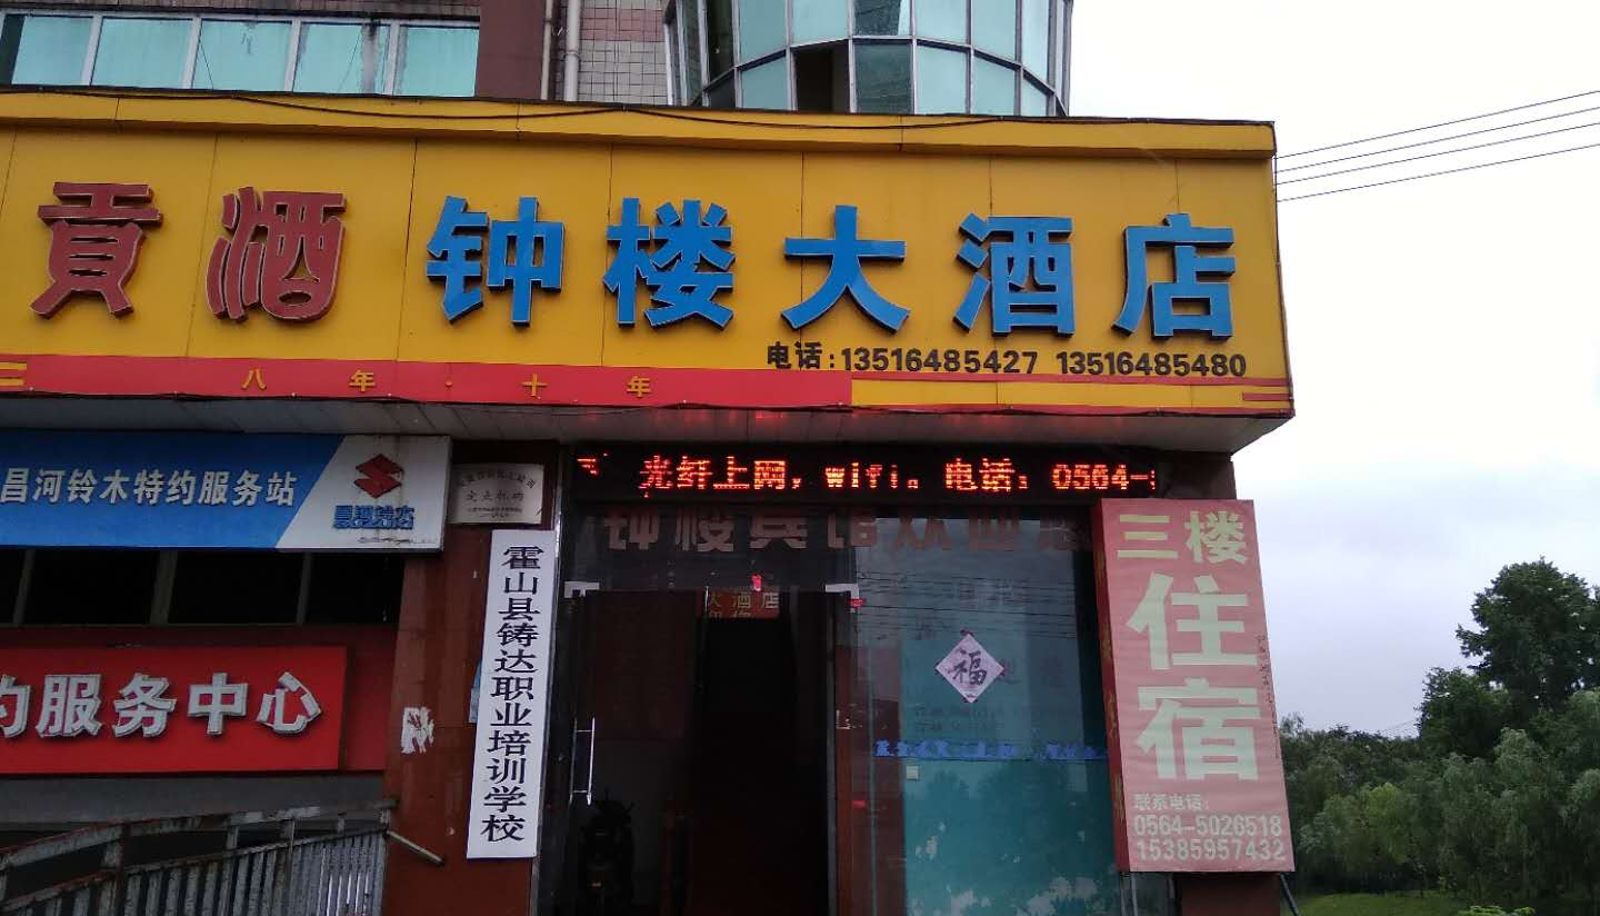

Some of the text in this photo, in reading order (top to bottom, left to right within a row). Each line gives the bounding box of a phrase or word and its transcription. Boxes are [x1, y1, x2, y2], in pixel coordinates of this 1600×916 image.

[29, 181, 347, 323] 贡酒
[426, 195, 1236, 340] 钟楼大酒店
[1056, 350, 1246, 378] 13516485480
[1, 467, 297, 506] 昌河铃木特约服务站
[1051, 462, 1156, 492] 0564-
[1117, 510, 1248, 565] 三楼
[950, 648, 988, 687] 福
[1126, 573, 1262, 780] 住宿
[480, 545, 544, 842] 霍山县铸达职业培训学校
[1133, 814, 1283, 838] 0564-5026518
[1137, 839, 1286, 862] 15385957432
